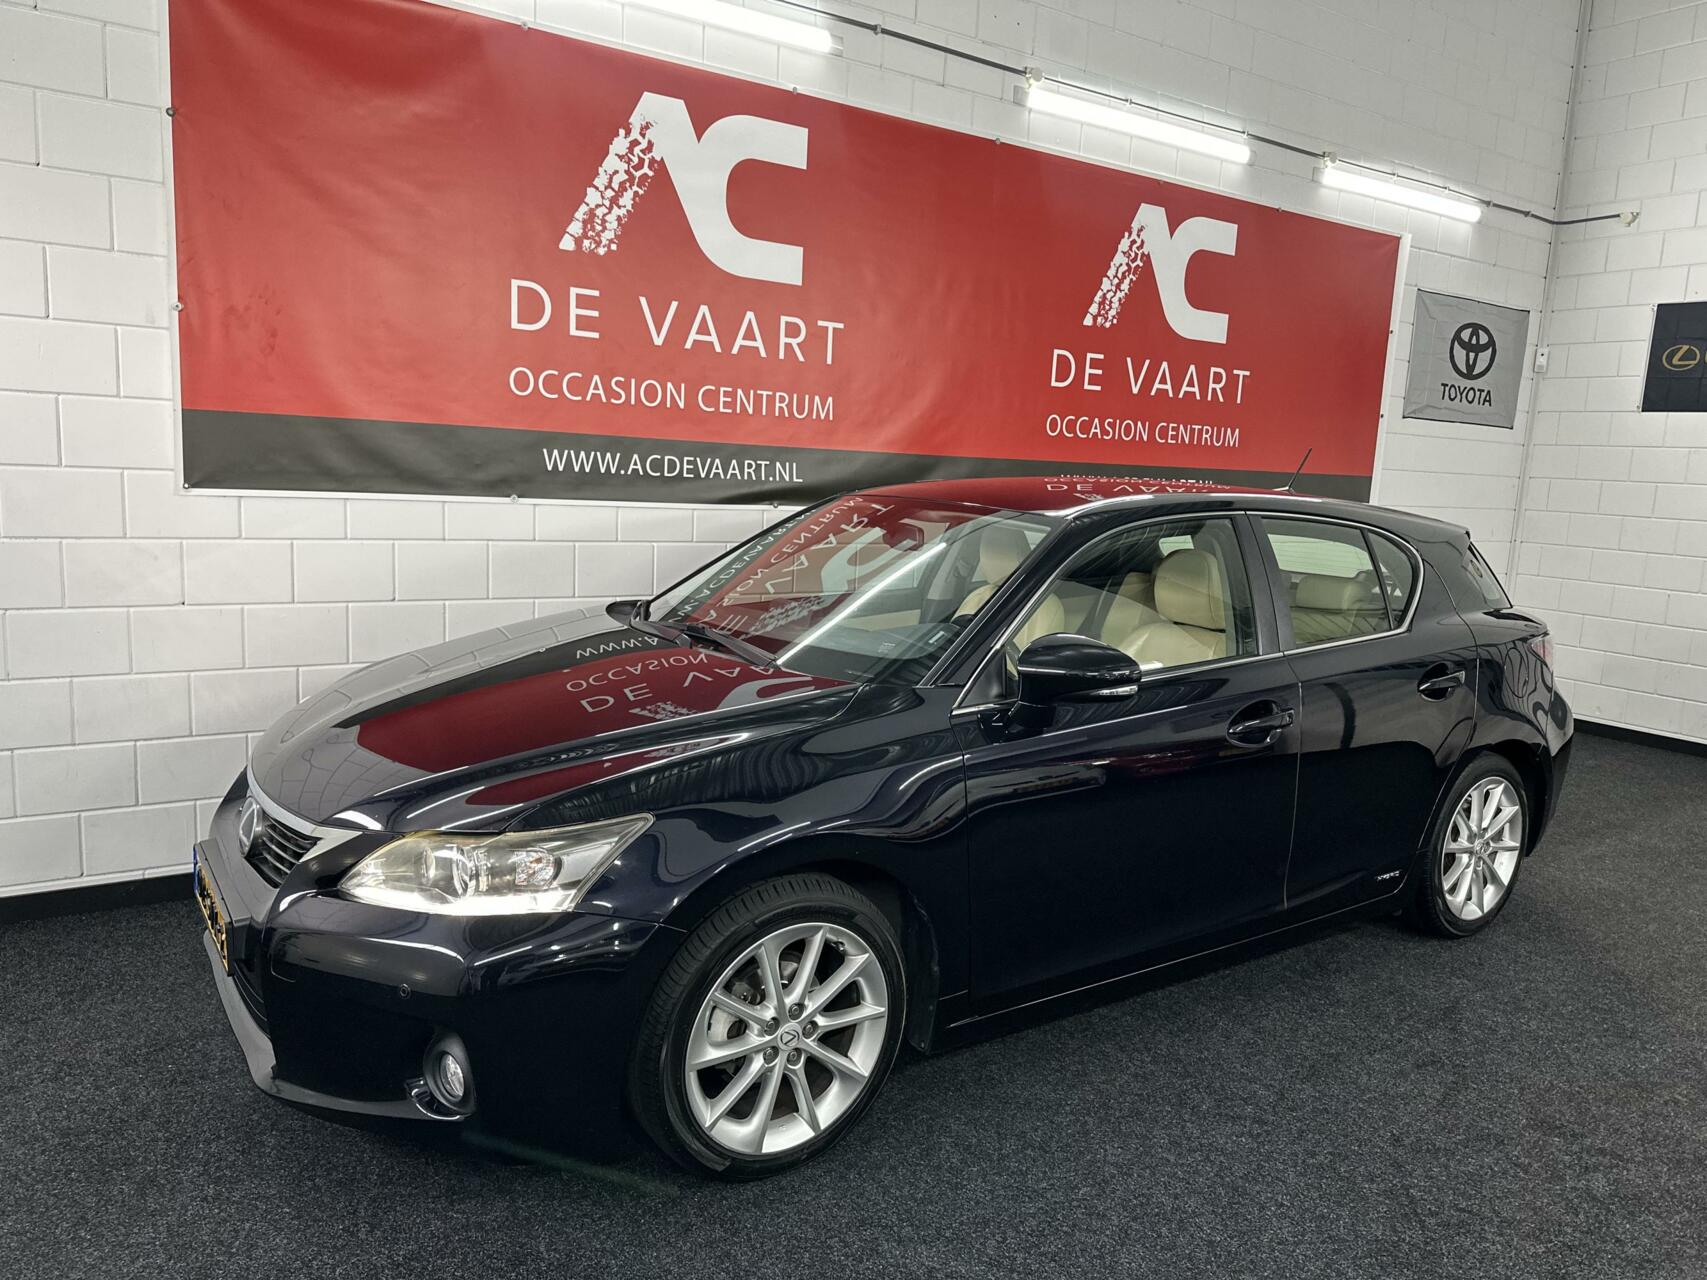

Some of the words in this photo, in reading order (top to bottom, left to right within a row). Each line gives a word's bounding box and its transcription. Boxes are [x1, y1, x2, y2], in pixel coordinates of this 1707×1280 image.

[559, 91, 808, 286] AC
[1083, 203, 1238, 344] AC
[510, 278, 600, 339] DE
[639, 295, 845, 366] VAART
[509, 366, 685, 410] OCCASION
[698, 385, 834, 421] CENTRUM
[1050, 349, 1104, 391] DE
[1126, 356, 1251, 404] VAART
[1440, 382, 1492, 407] TOYOTA
[1046, 414, 1149, 442] OCCASION
[1155, 422, 1240, 448] CENTRUM
[543, 447, 804, 483] WWW.ACDEVAART.NL
